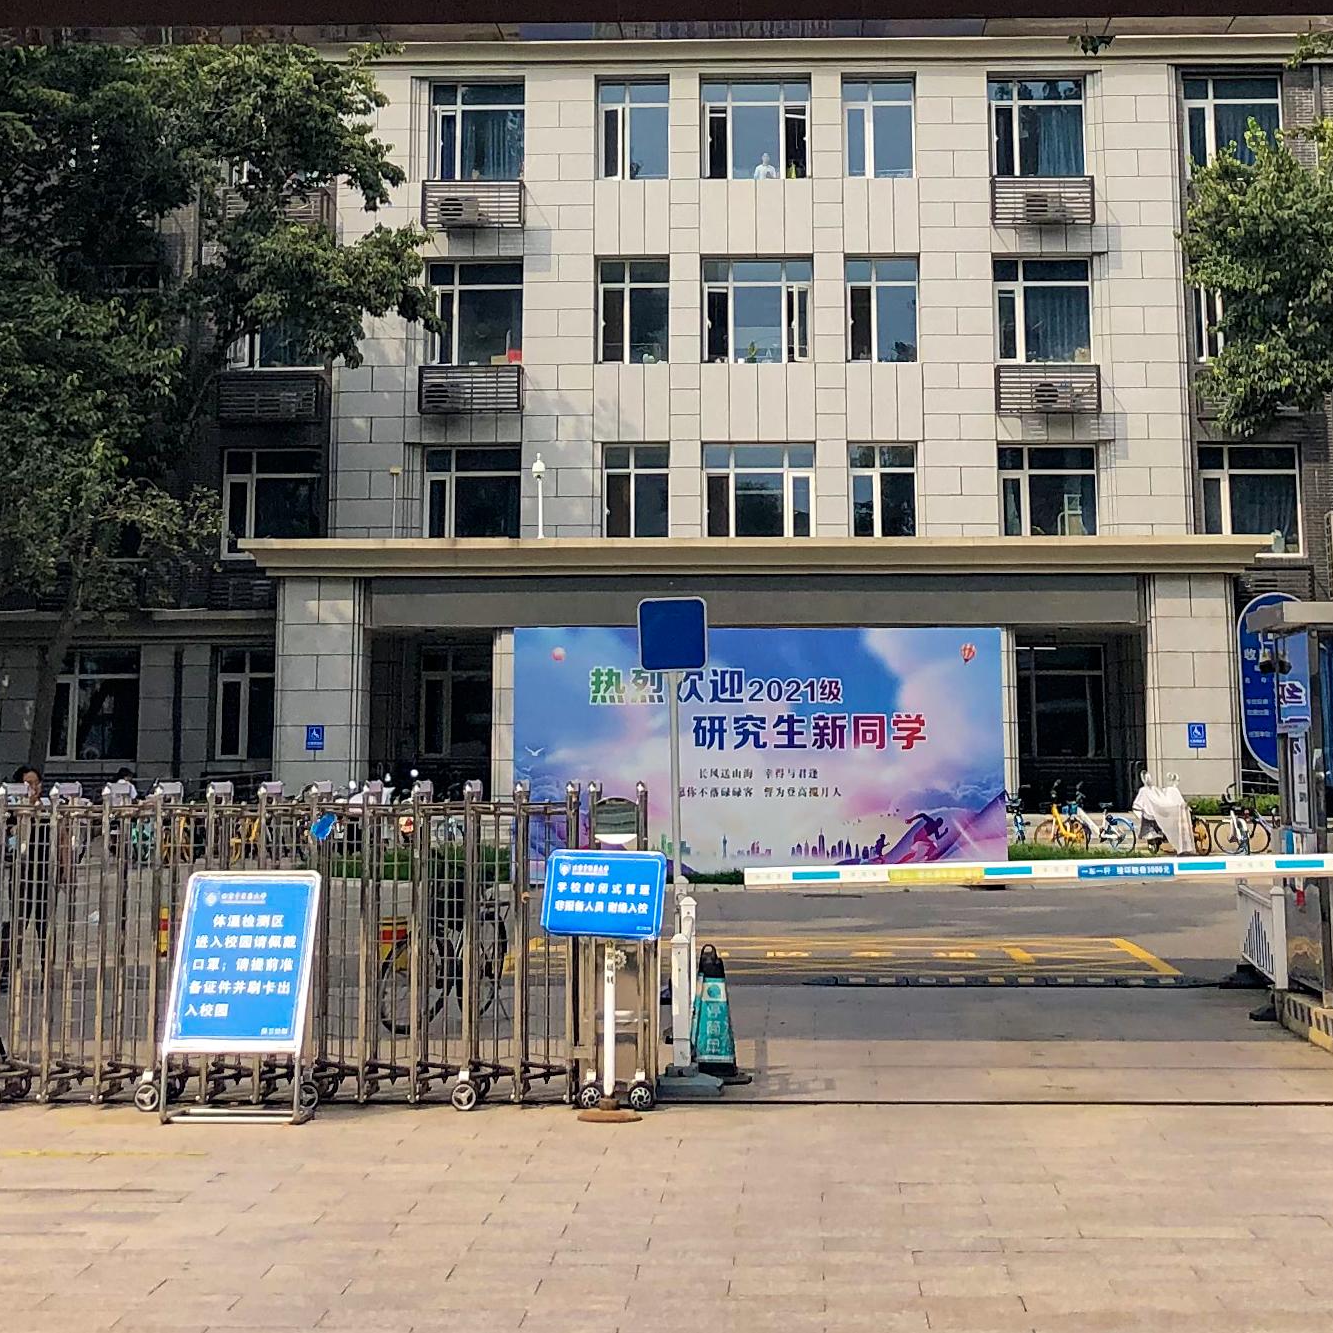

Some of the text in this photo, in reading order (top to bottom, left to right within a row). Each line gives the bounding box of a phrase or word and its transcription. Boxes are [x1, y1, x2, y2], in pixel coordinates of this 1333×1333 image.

[693, 714, 926, 750] 研究生新同学
[699, 768, 753, 779] 长风送山海
[213, 914, 284, 928] 体温检测区
[195, 935, 297, 949] 进入校园请佩戴
[189, 980, 291, 995] 备证件并刷卡出
[184, 1003, 229, 1017] 入校园
